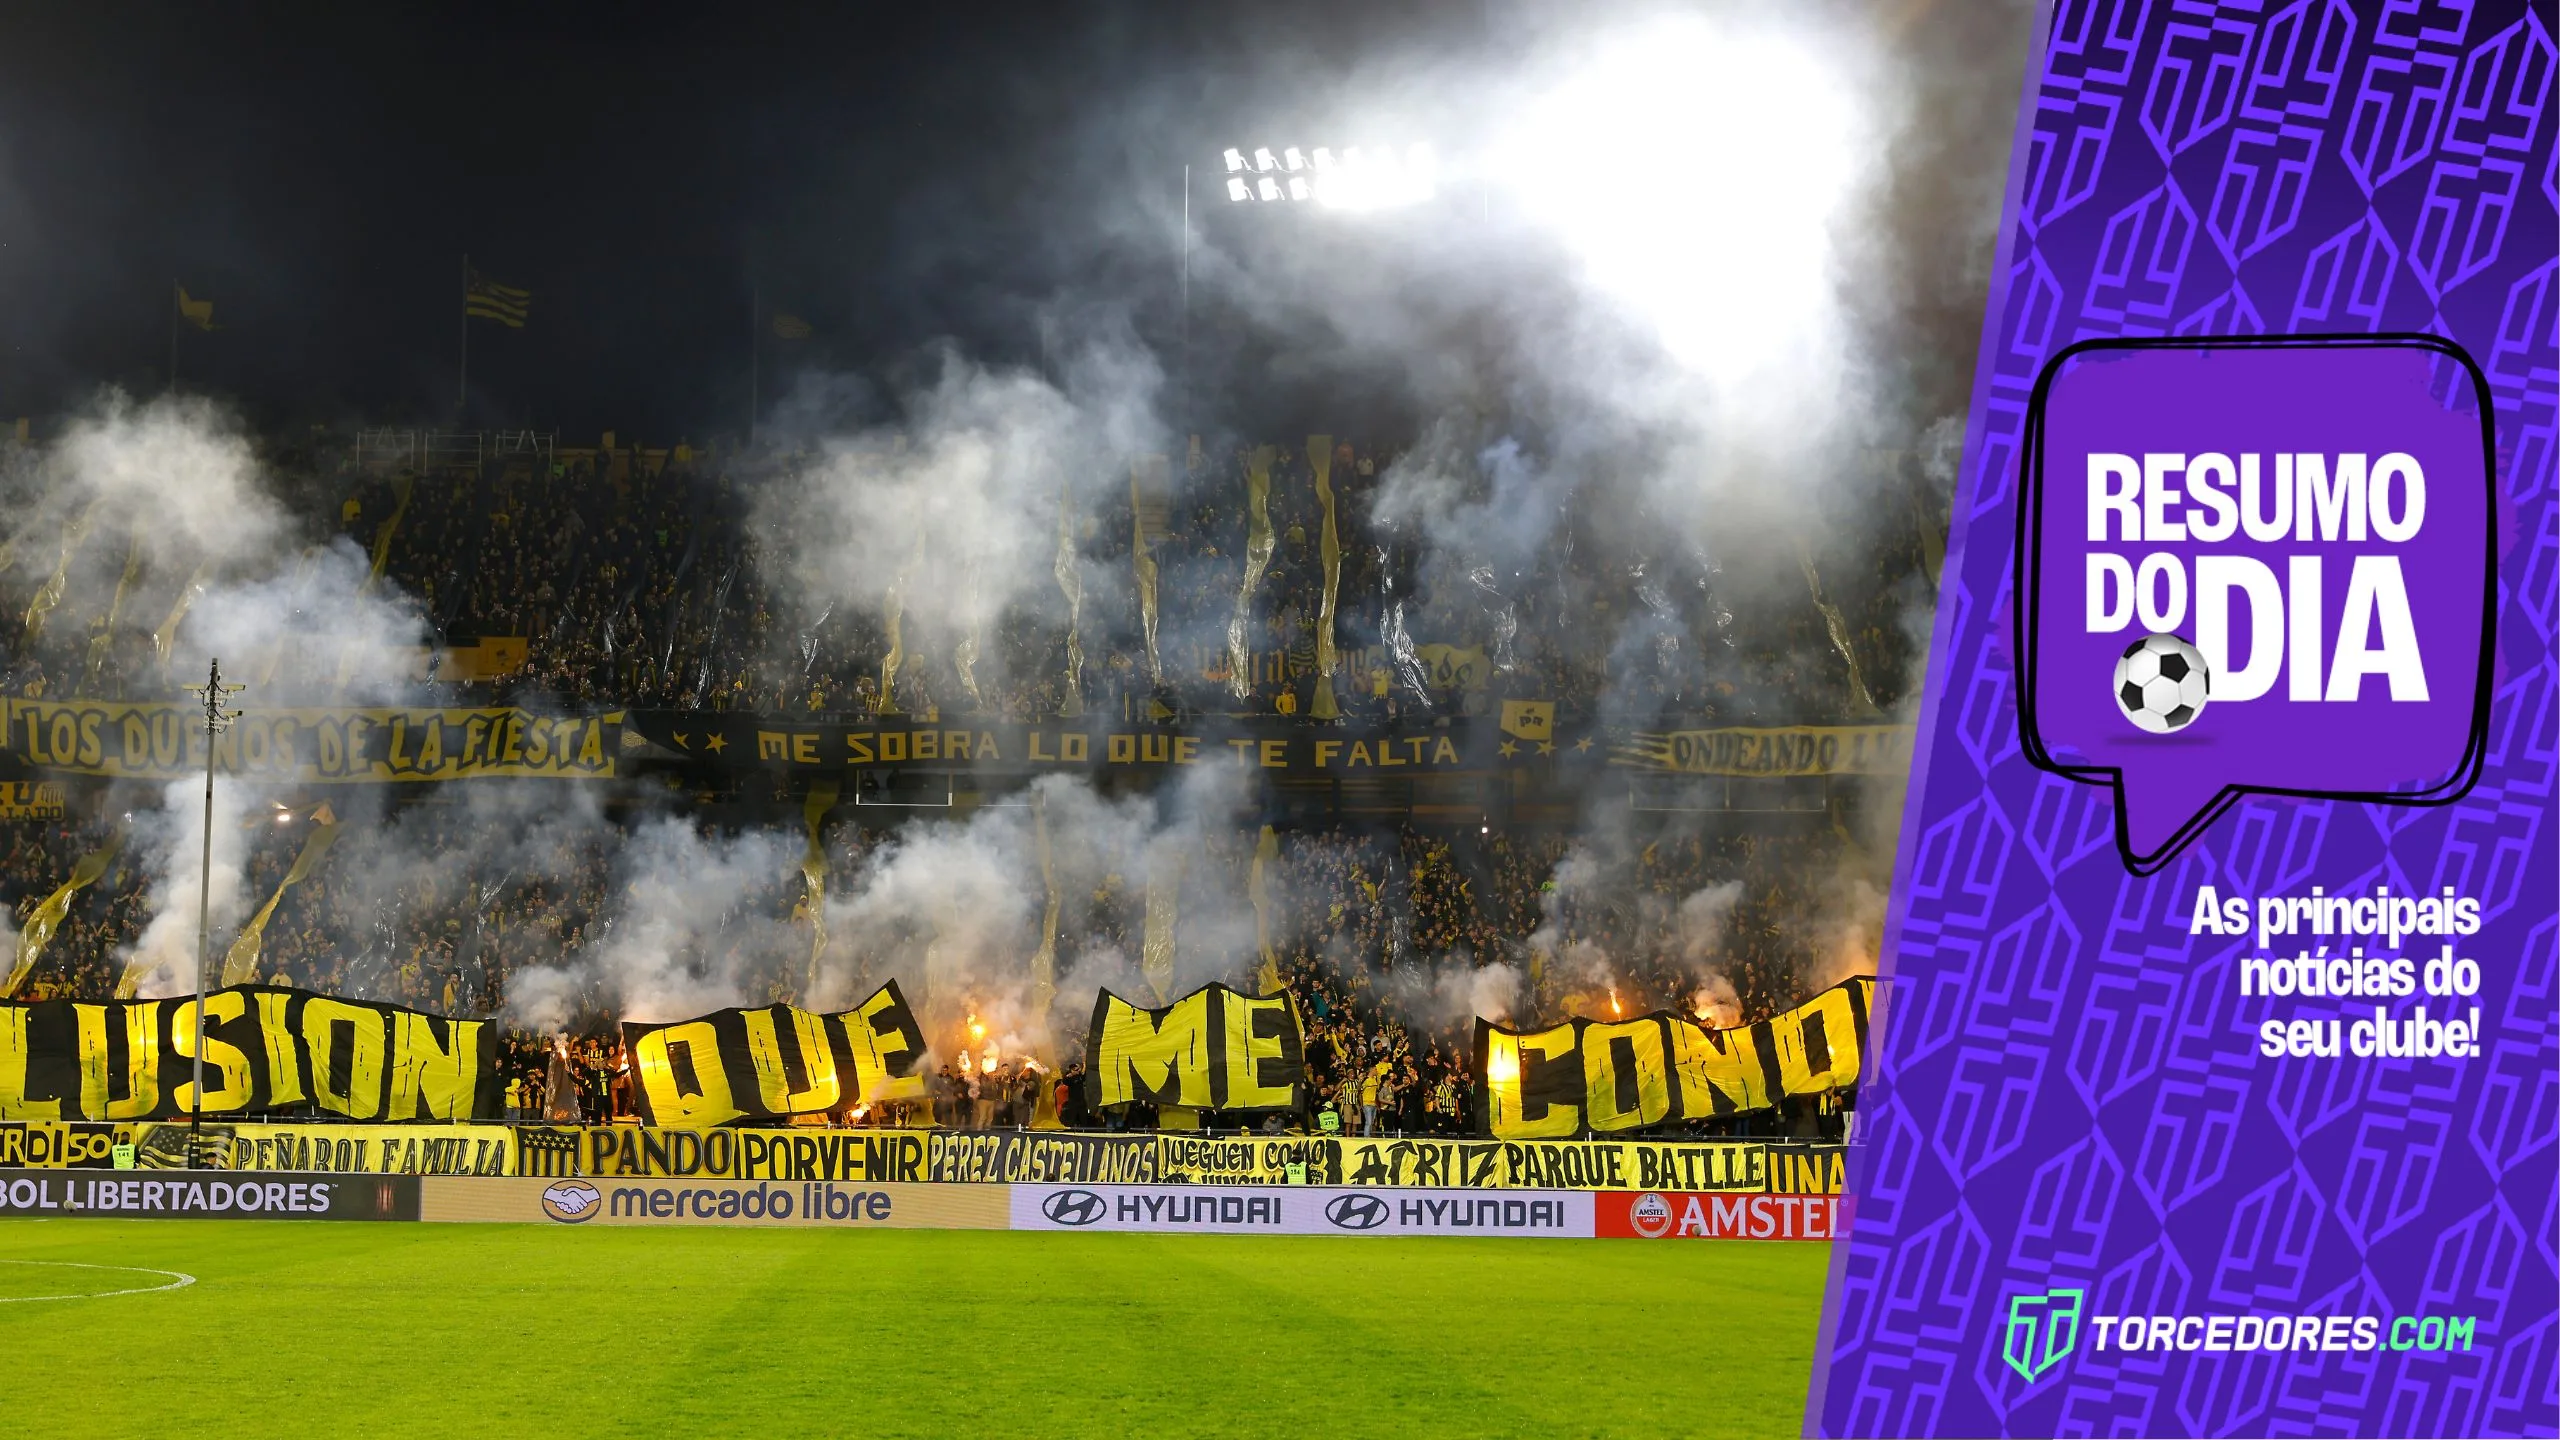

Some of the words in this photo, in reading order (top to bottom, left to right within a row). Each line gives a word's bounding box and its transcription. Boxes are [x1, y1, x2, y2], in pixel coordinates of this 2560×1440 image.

[26, 709, 101, 768] LOS
[318, 716, 370, 780] DE
[388, 715, 443, 774] LA
[462, 711, 603, 768] FIESTA
[758, 730, 821, 764] ME
[847, 730, 999, 764] SOBRA
[1029, 732, 1088, 762] LO
[1108, 734, 1201, 765] QUE
[1229, 739, 1288, 768] TE
[1315, 736, 1458, 768] FALTA
[1672, 732, 1840, 774] ONDEANDO
[636, 988, 925, 1127] QUE
[1098, 988, 1295, 1108] ME
[235, 1132, 369, 1172] PEÑAROL
[380, 1137, 506, 1175] FAMILIA
[590, 1129, 732, 1175] PANDO
[1004, 1136, 1156, 1183] CASTELLANOS
[1505, 1142, 1627, 1188] PARQUE
[1637, 1144, 1766, 1190] BATLLE
[65, 1179, 331, 1213] LIBERTADORES
[610, 1183, 795, 1219] mercado
[801, 1182, 892, 1220] libre
[1117, 1195, 1281, 1224] HYUNDAI
[1400, 1199, 1563, 1228] HYUNDAI
[1638, 1208, 1665, 1216] AMSTEL
[1677, 1196, 1850, 1238] AMSTEL
